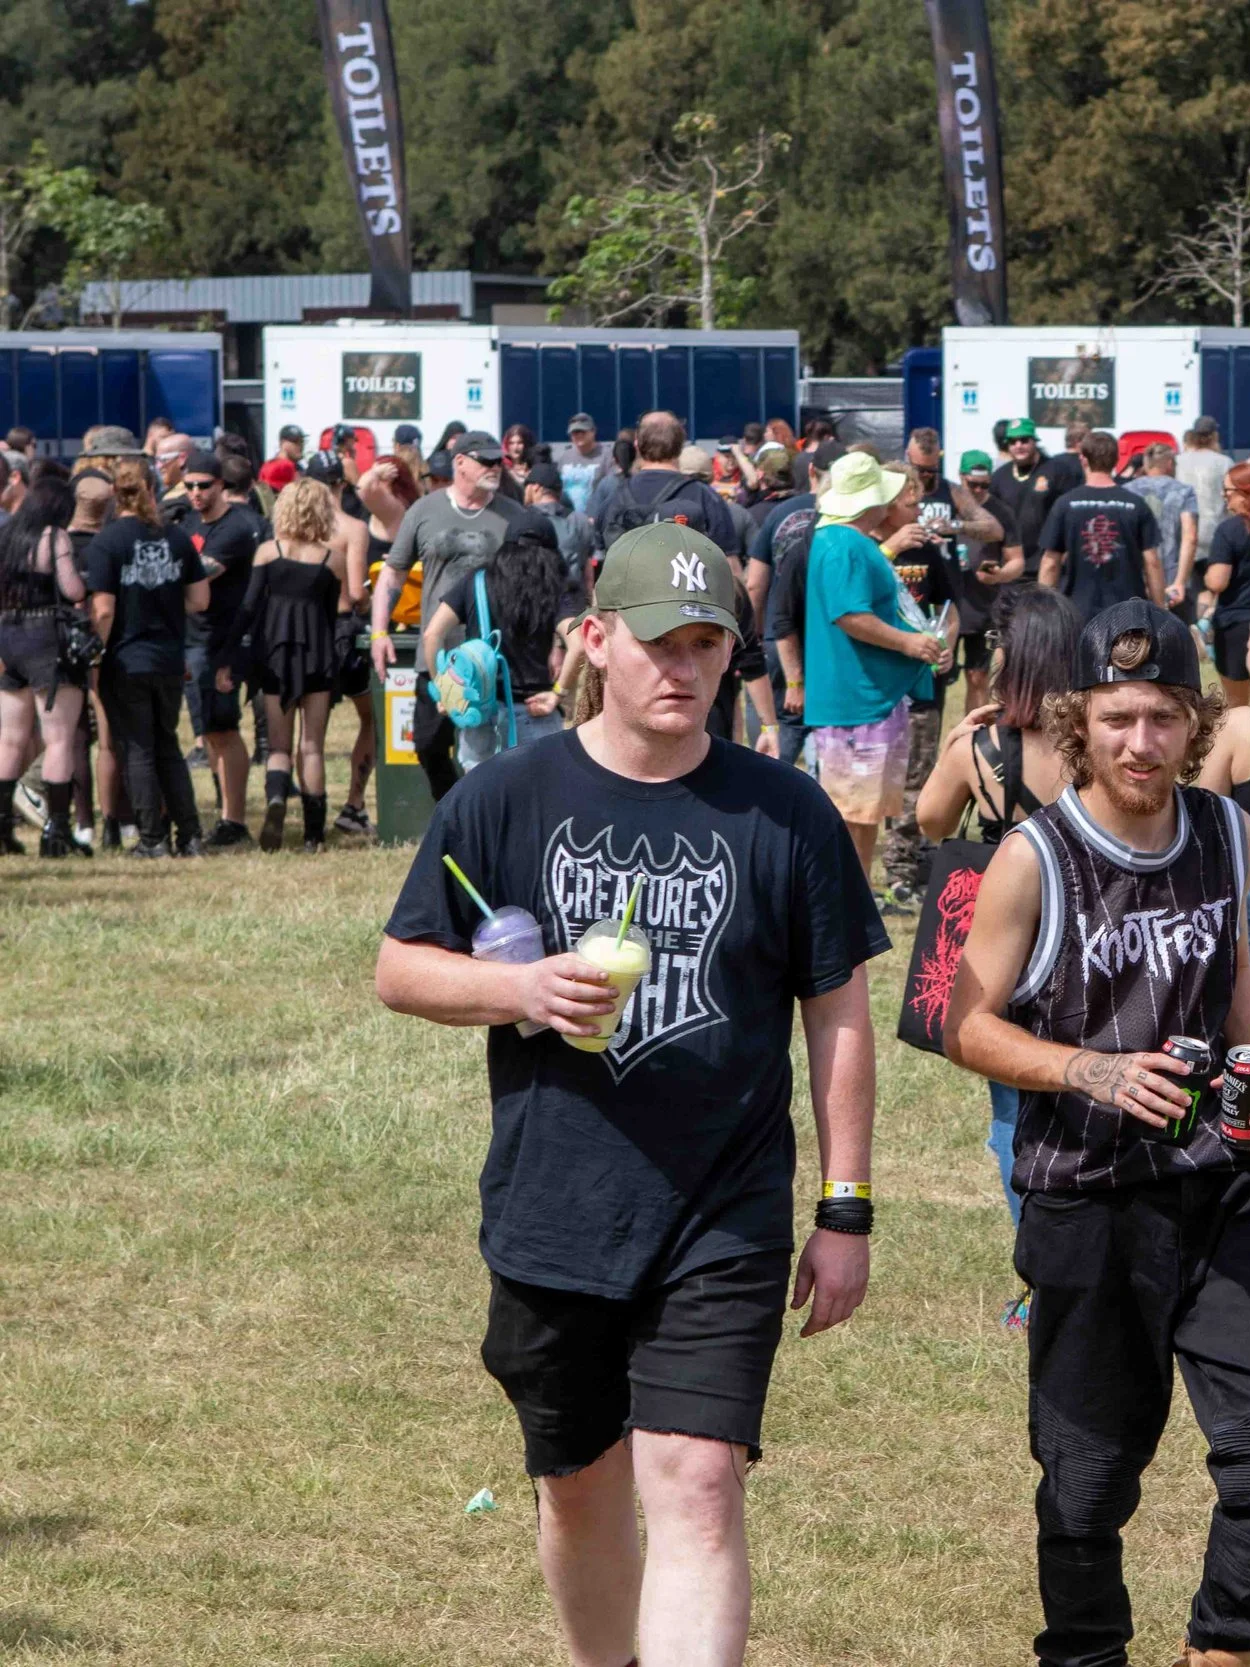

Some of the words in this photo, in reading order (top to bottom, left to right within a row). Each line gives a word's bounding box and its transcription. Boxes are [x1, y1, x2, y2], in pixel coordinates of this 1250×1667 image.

[337, 22, 402, 237] TOILETS
[951, 51, 997, 273] TOILETS
[345, 376, 416, 393] TOILETS
[1032, 382, 1109, 400] TOILETS
[670, 551, 708, 592] NY
[559, 859, 723, 930] CREATURES
[647, 929, 681, 950] HE
